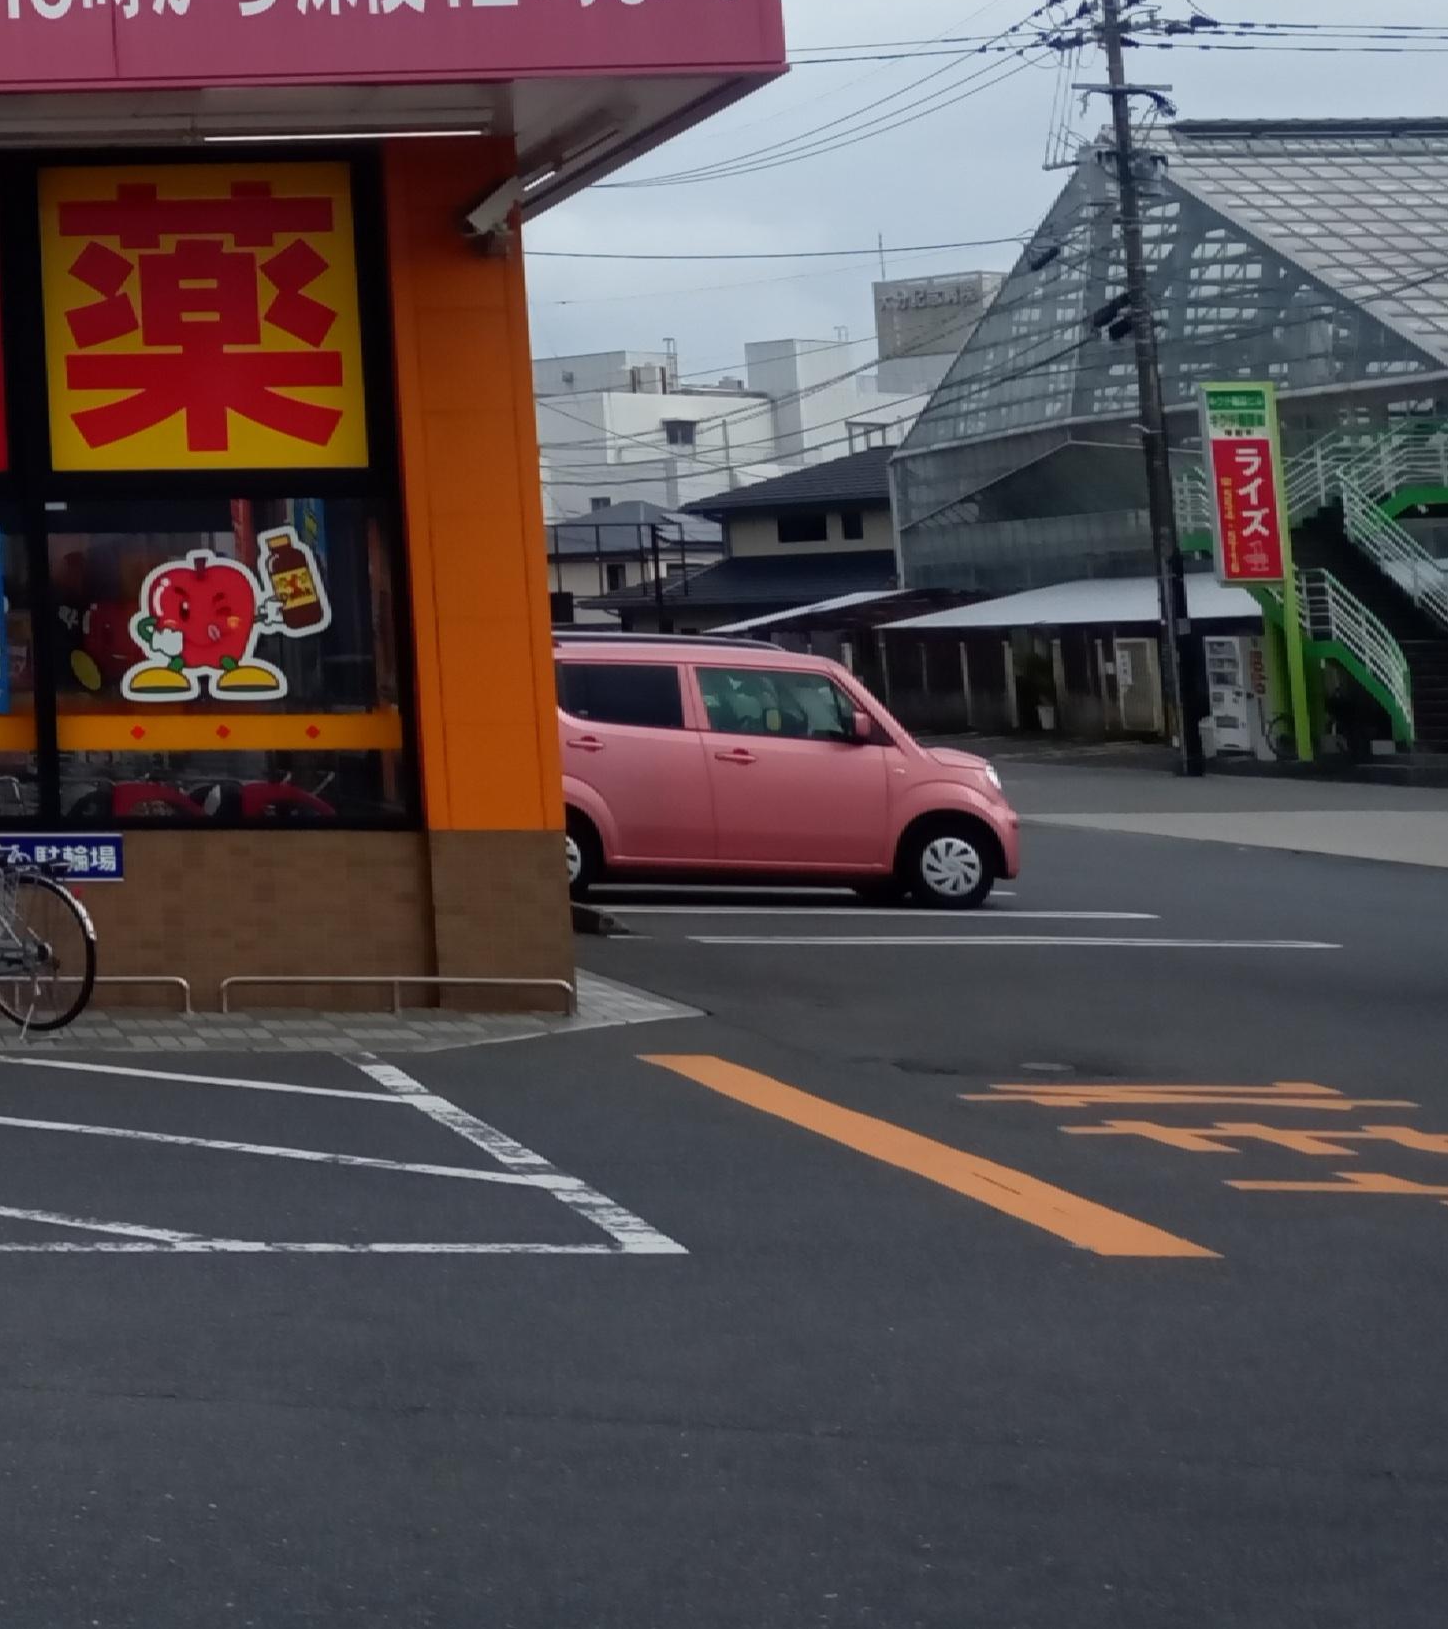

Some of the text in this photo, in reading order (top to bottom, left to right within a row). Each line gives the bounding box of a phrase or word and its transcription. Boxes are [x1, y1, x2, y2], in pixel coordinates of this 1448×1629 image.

[58, 182, 343, 451] 薬
[1235, 448, 1270, 537] ライズ
